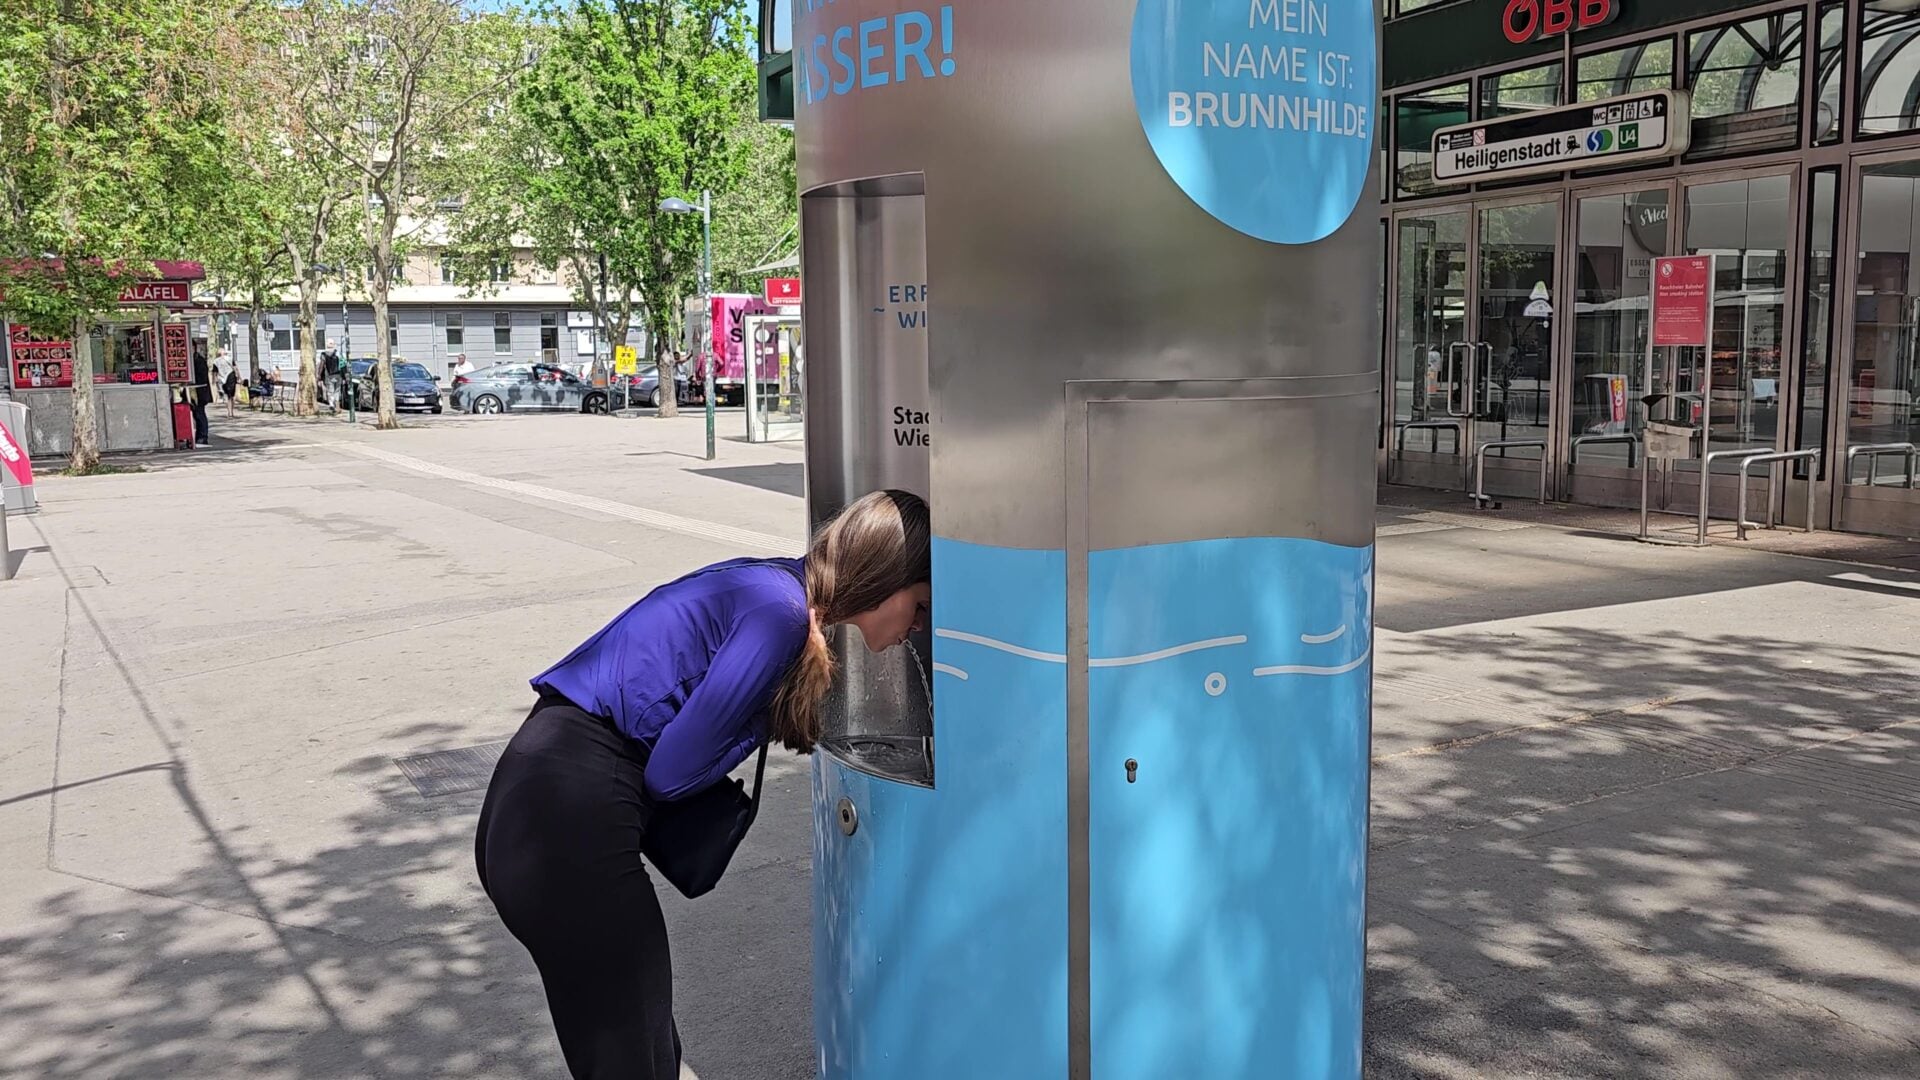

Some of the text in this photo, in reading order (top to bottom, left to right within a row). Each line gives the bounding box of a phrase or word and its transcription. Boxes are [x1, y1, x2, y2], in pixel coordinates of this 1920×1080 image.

[1250, 0, 1327, 36] MEIN
[1203, 41, 1353, 90] NAME IST:
[1168, 91, 1367, 139] BRUNNHILDE
[1593, 111, 1606, 120] WC
[1620, 129, 1637, 144] U4
[1455, 137, 1561, 170] Heiligenstadt
[131, 371, 157, 382] KEBAP
